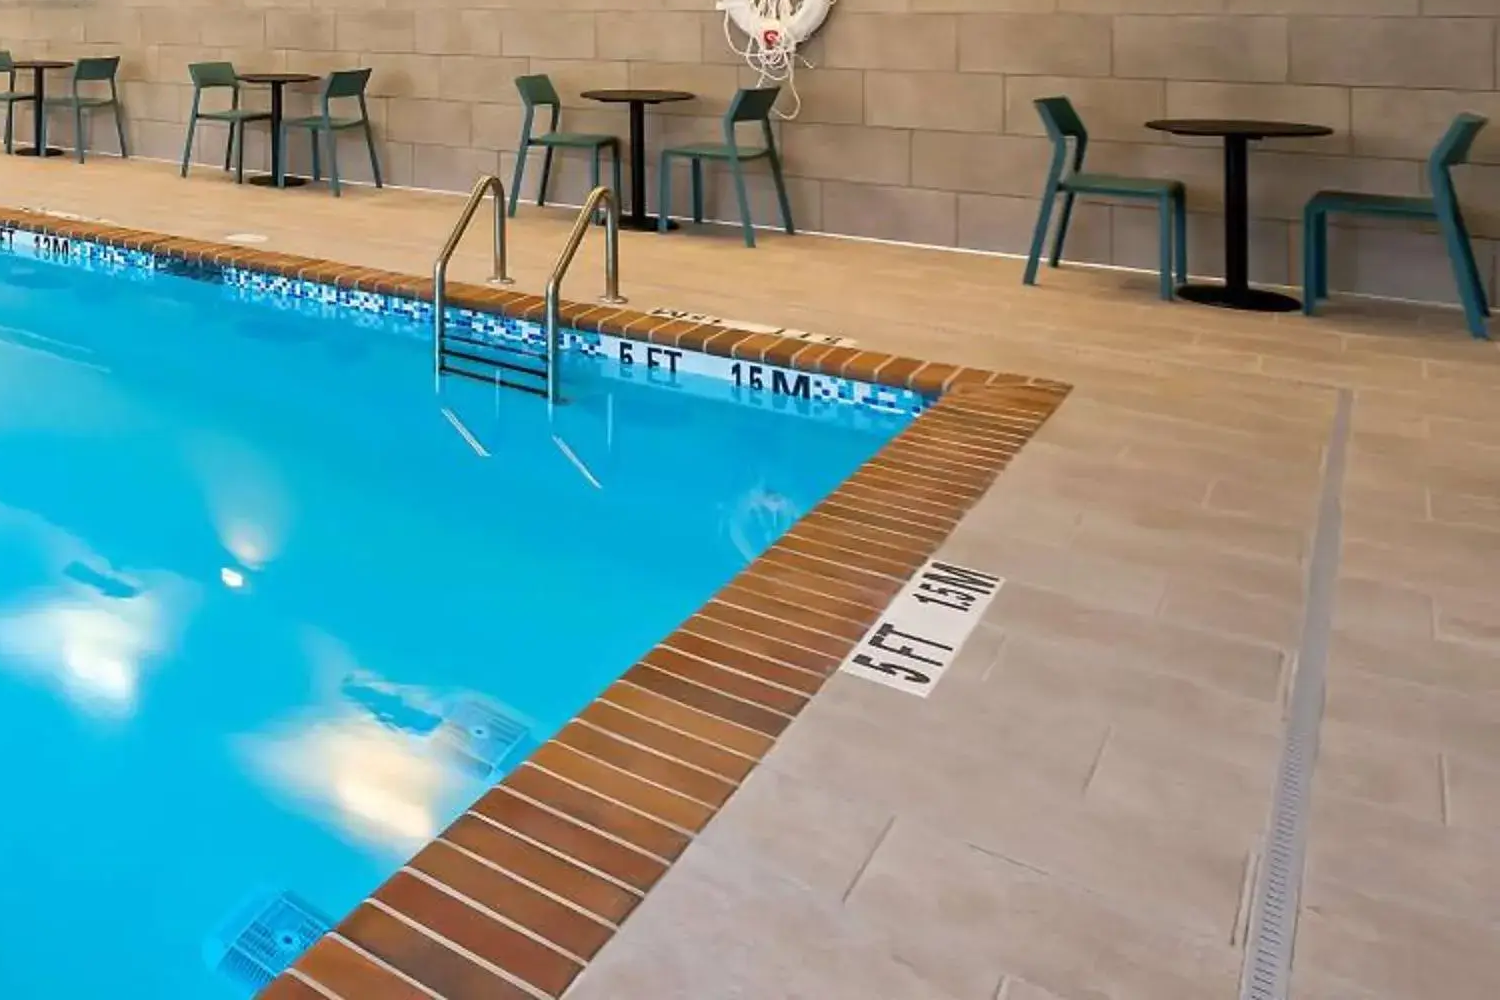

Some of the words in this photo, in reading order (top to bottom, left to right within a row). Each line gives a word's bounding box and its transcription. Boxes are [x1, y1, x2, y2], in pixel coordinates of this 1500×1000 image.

[619, 341, 633, 365] 5
[647, 347, 682, 373] FT
[867, 622, 954, 667] FT
[851, 653, 931, 685] 5
